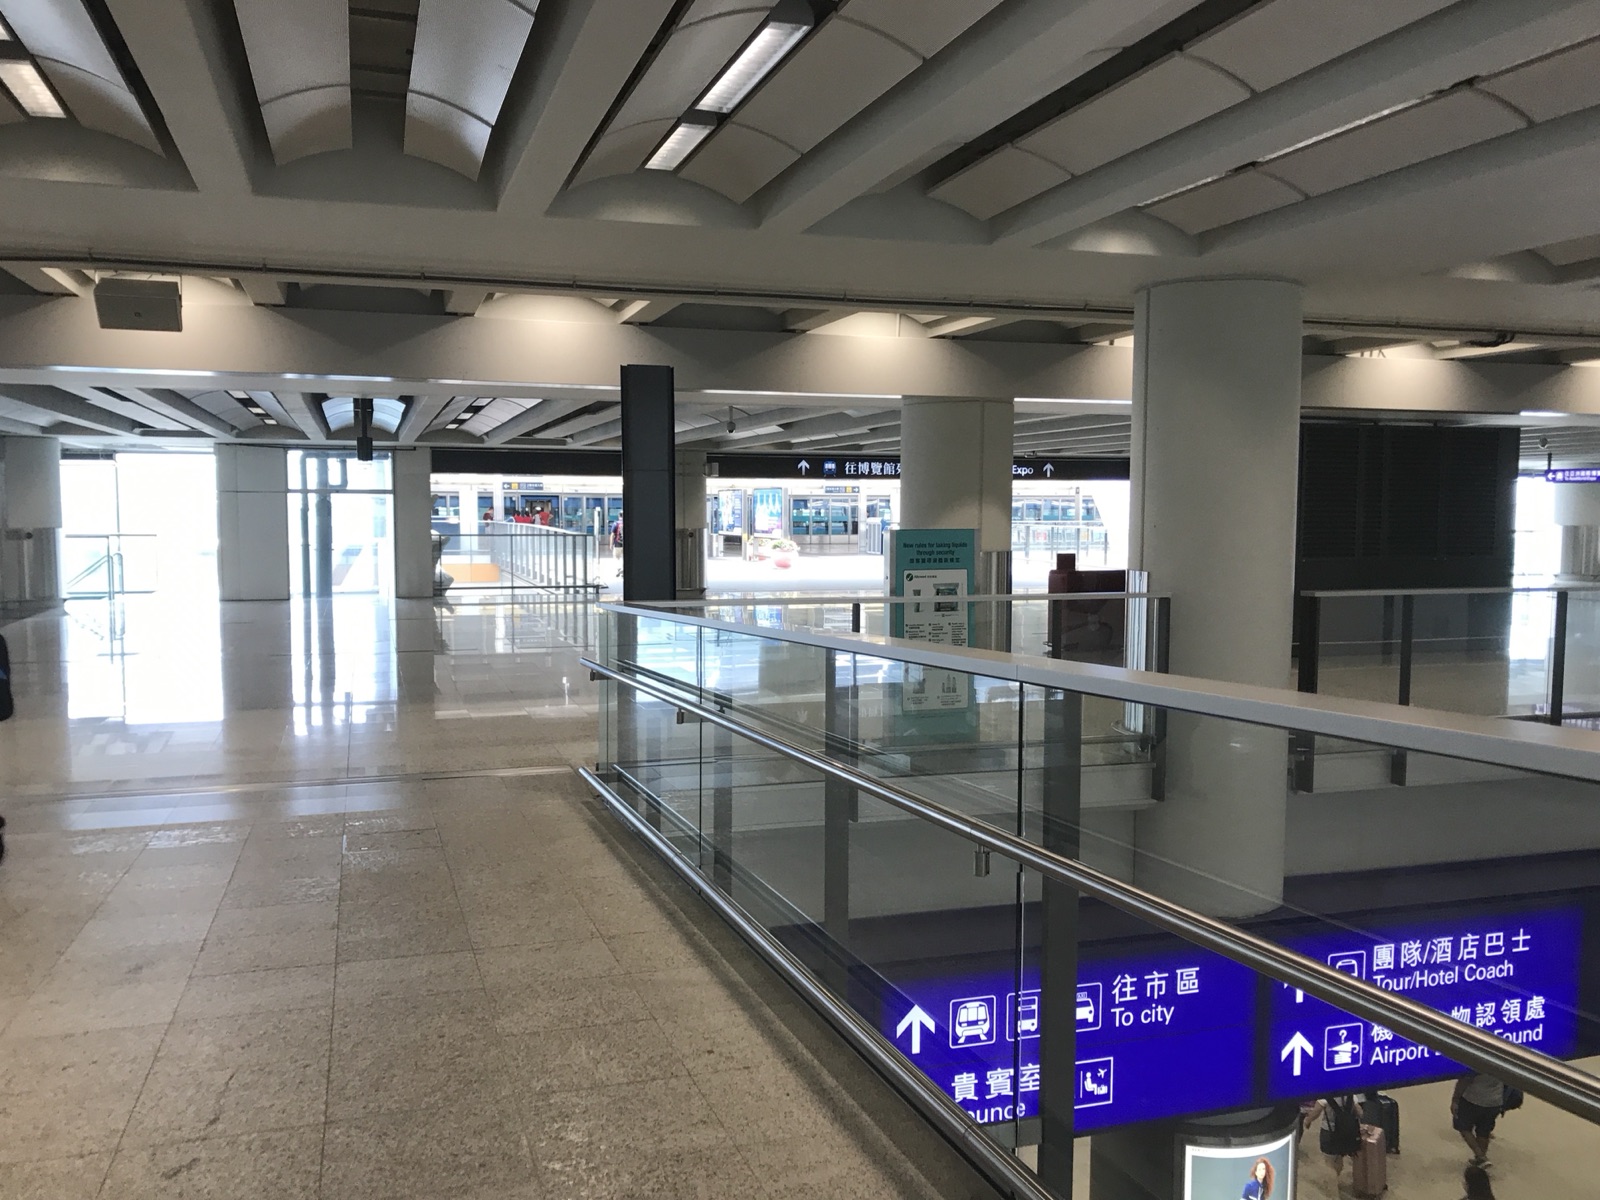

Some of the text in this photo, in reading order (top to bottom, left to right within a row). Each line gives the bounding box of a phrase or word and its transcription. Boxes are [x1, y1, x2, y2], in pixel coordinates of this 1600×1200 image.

[1372, 928, 1532, 972] 團隊/酒店巴士
[1111, 967, 1200, 1004] 往市區
[1373, 959, 1514, 991] Tour/Hotel Coach
[1110, 1003, 1175, 1028] To city
[951, 1062, 1041, 1103] 貴賓室
